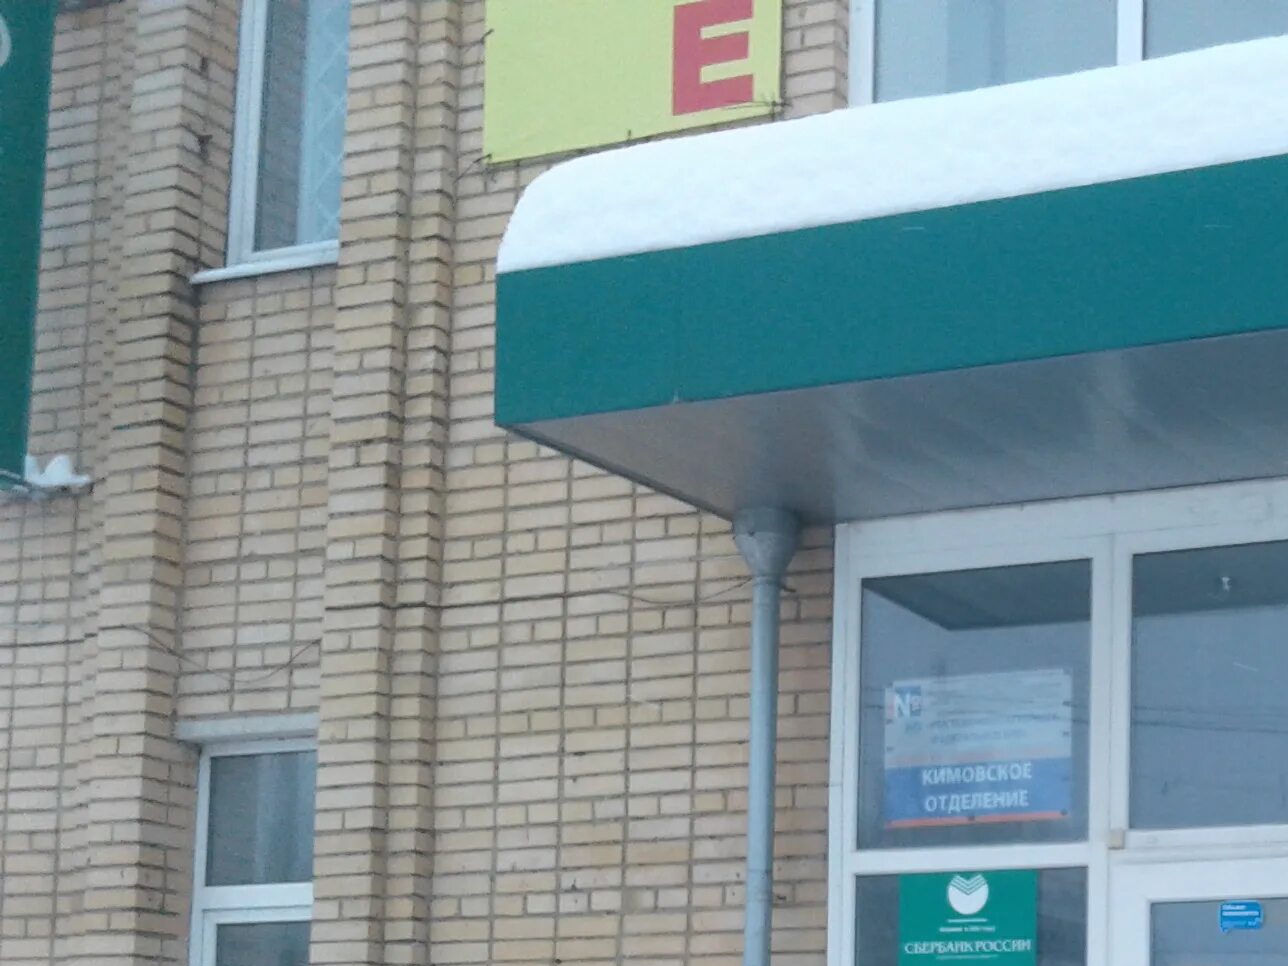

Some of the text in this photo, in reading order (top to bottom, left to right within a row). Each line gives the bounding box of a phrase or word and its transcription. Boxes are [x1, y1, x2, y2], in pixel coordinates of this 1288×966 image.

[922, 761, 1033, 785] КИМОВСКОЕ
[925, 790, 1030, 813] ОТДЕЛЕНИЕ
[904, 938, 1032, 954] СБЕРБАНК РОССИИ
